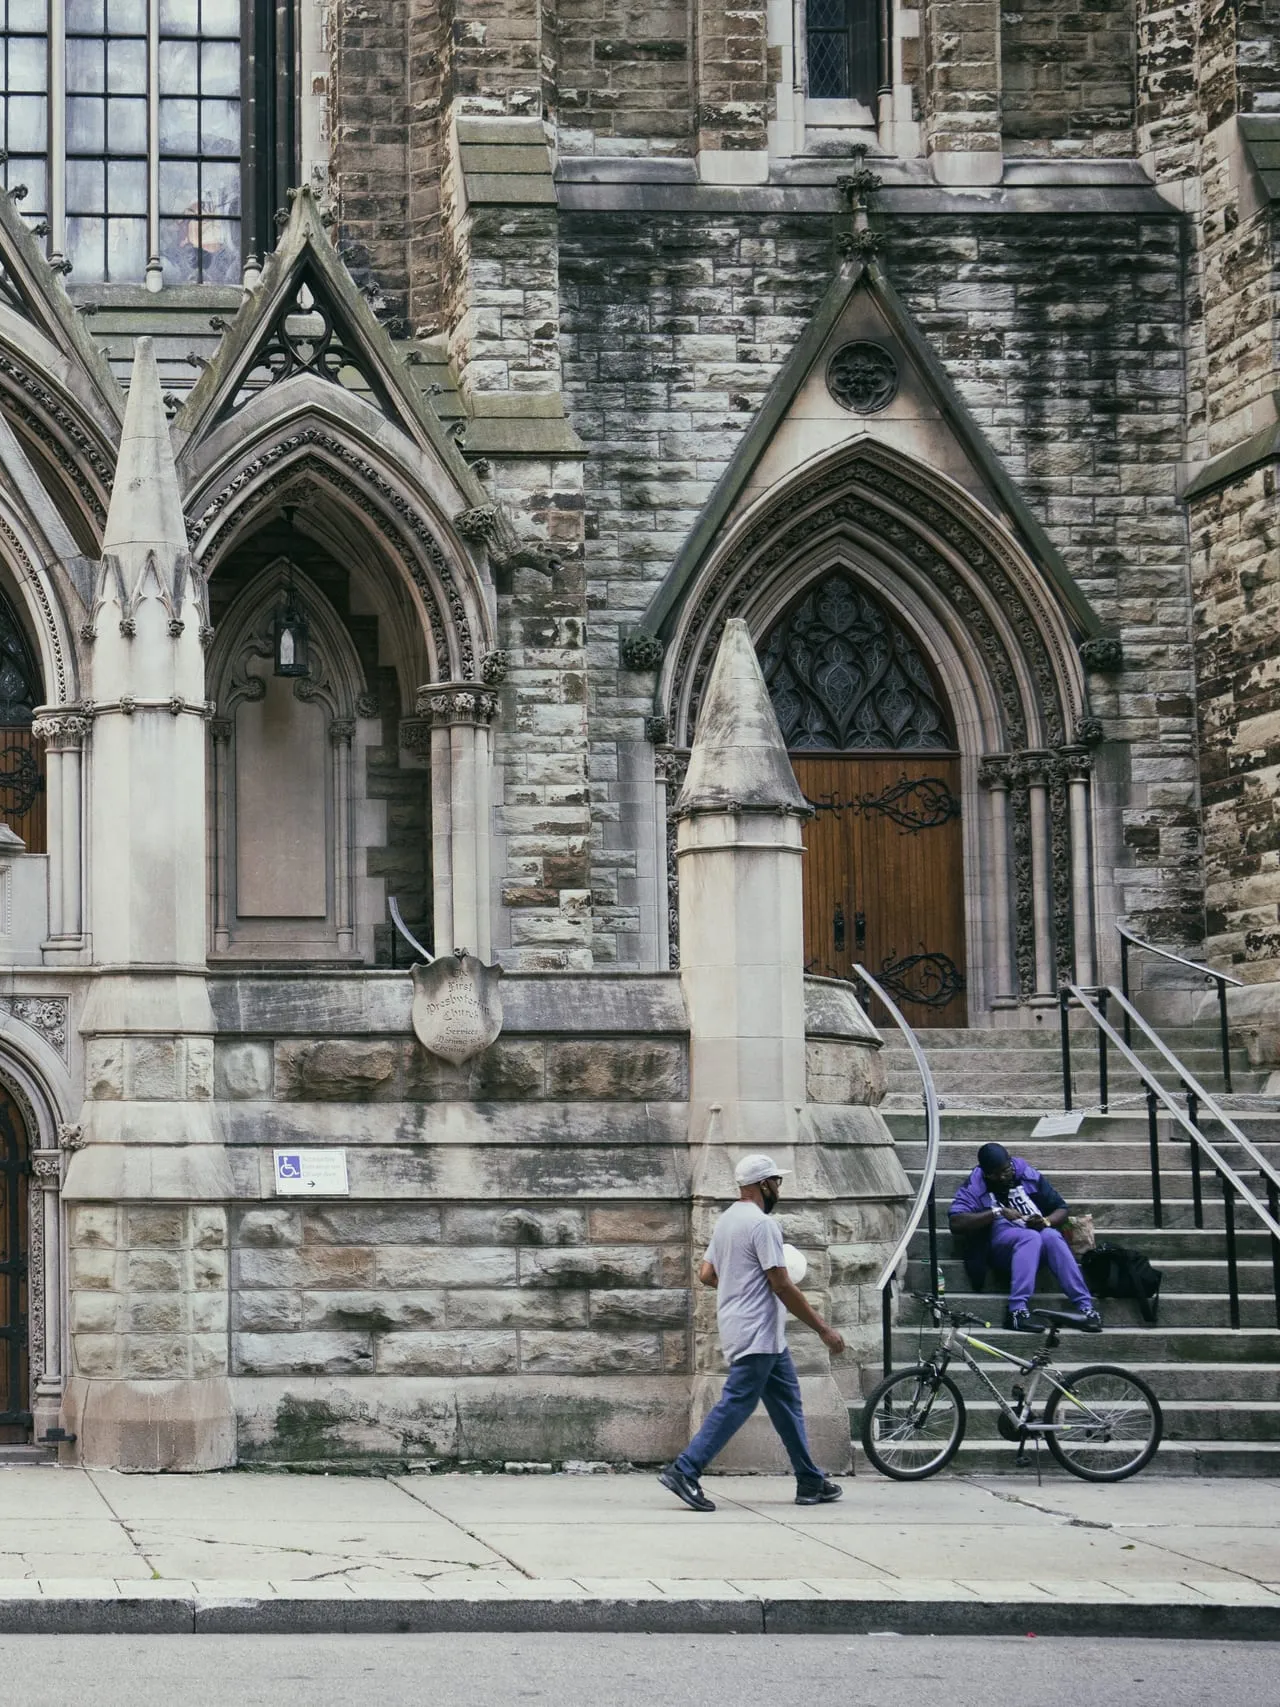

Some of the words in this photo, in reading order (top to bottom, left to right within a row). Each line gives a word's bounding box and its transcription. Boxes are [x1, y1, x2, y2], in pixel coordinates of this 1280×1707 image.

[448, 981, 473, 992] First
[426, 994, 490, 1016] Presbyterian
[443, 1008, 478, 1020] Church
